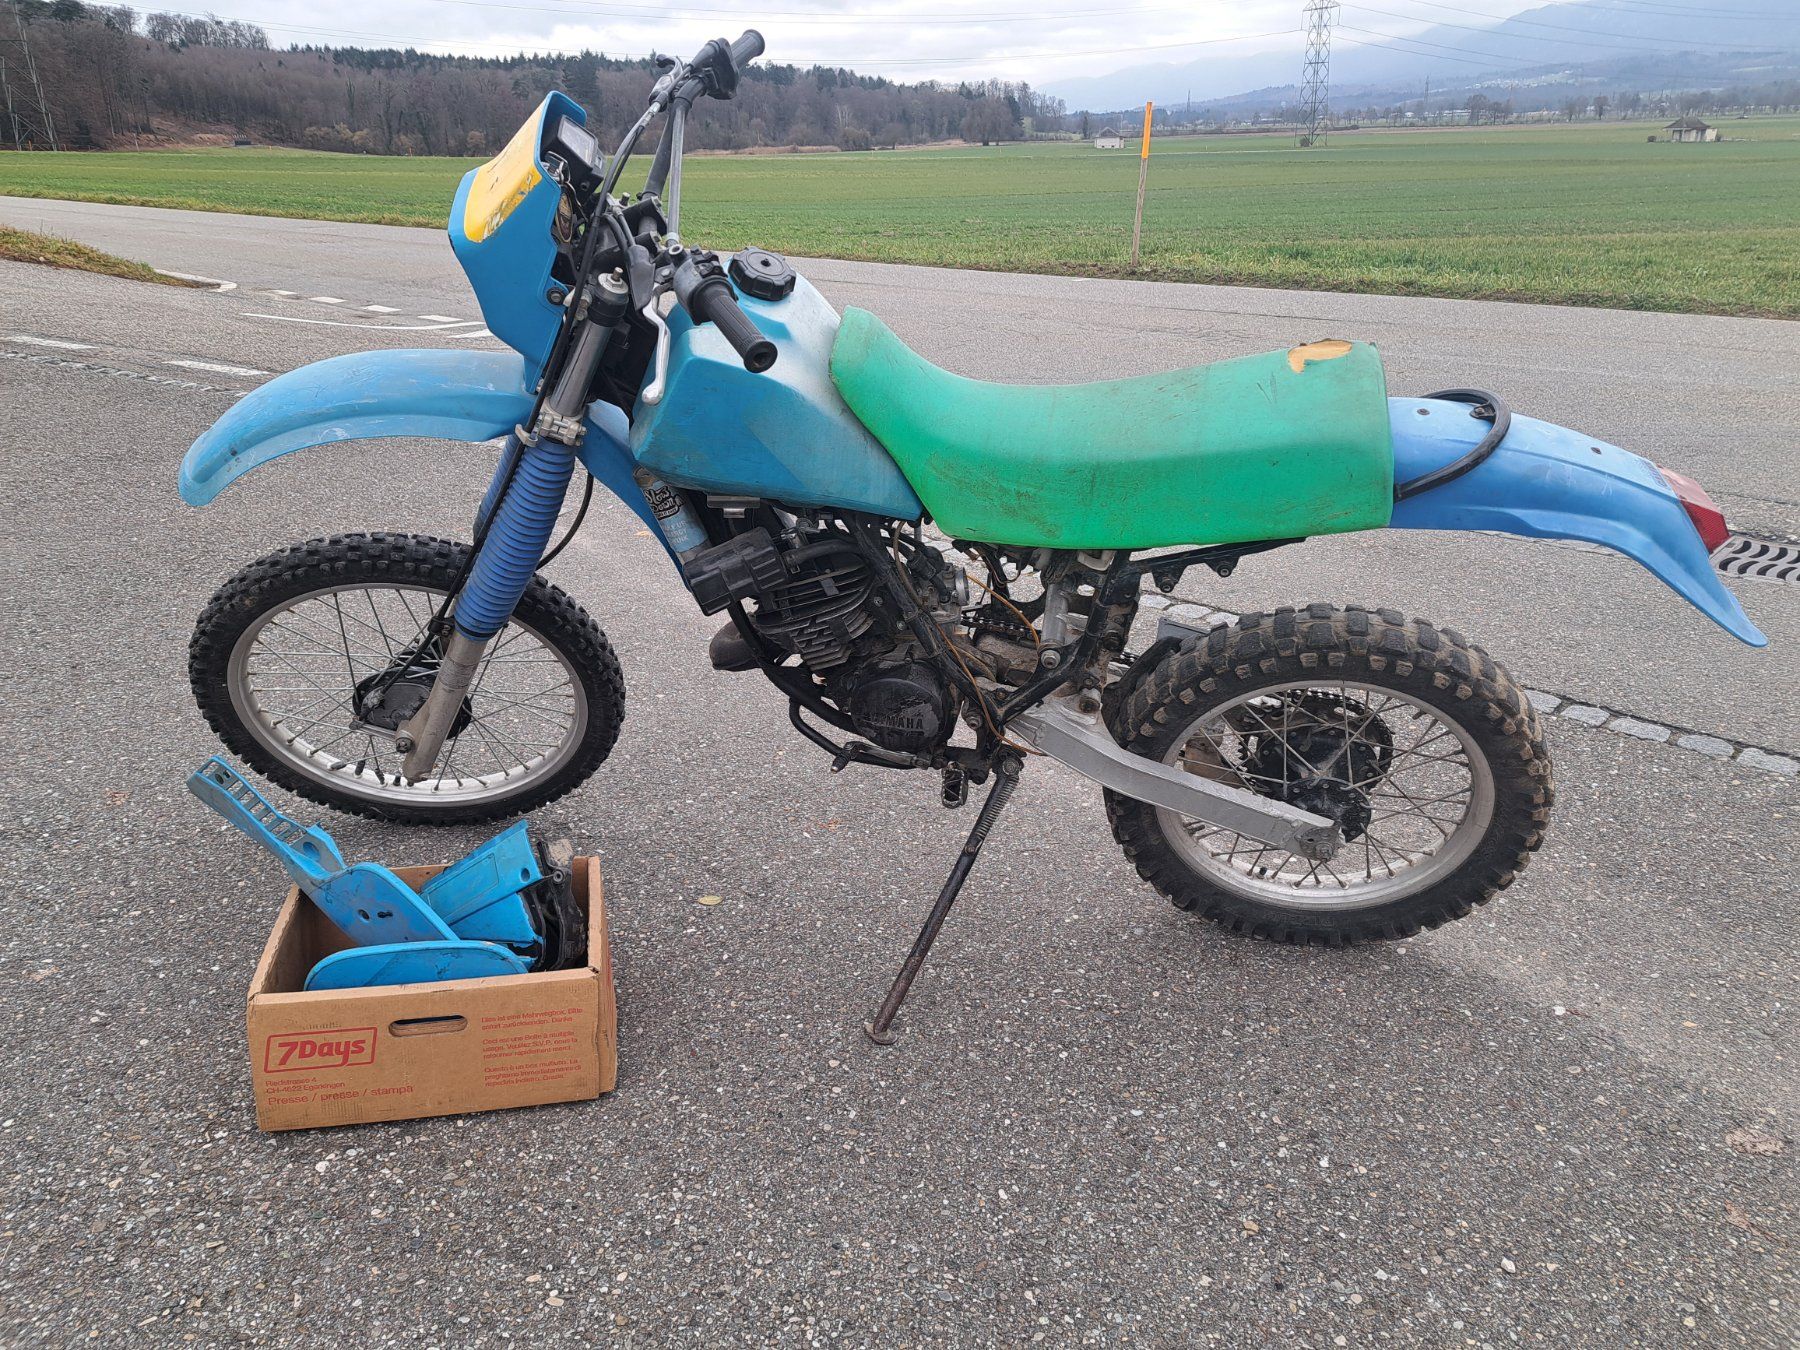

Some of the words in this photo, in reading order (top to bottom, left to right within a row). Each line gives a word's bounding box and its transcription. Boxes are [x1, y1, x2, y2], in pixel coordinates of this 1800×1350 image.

[278, 1039, 366, 1066] 7Days
[268, 1095, 310, 1106] Presse
[320, 1090, 360, 1102] presse
[371, 1084, 414, 1096] stampa
